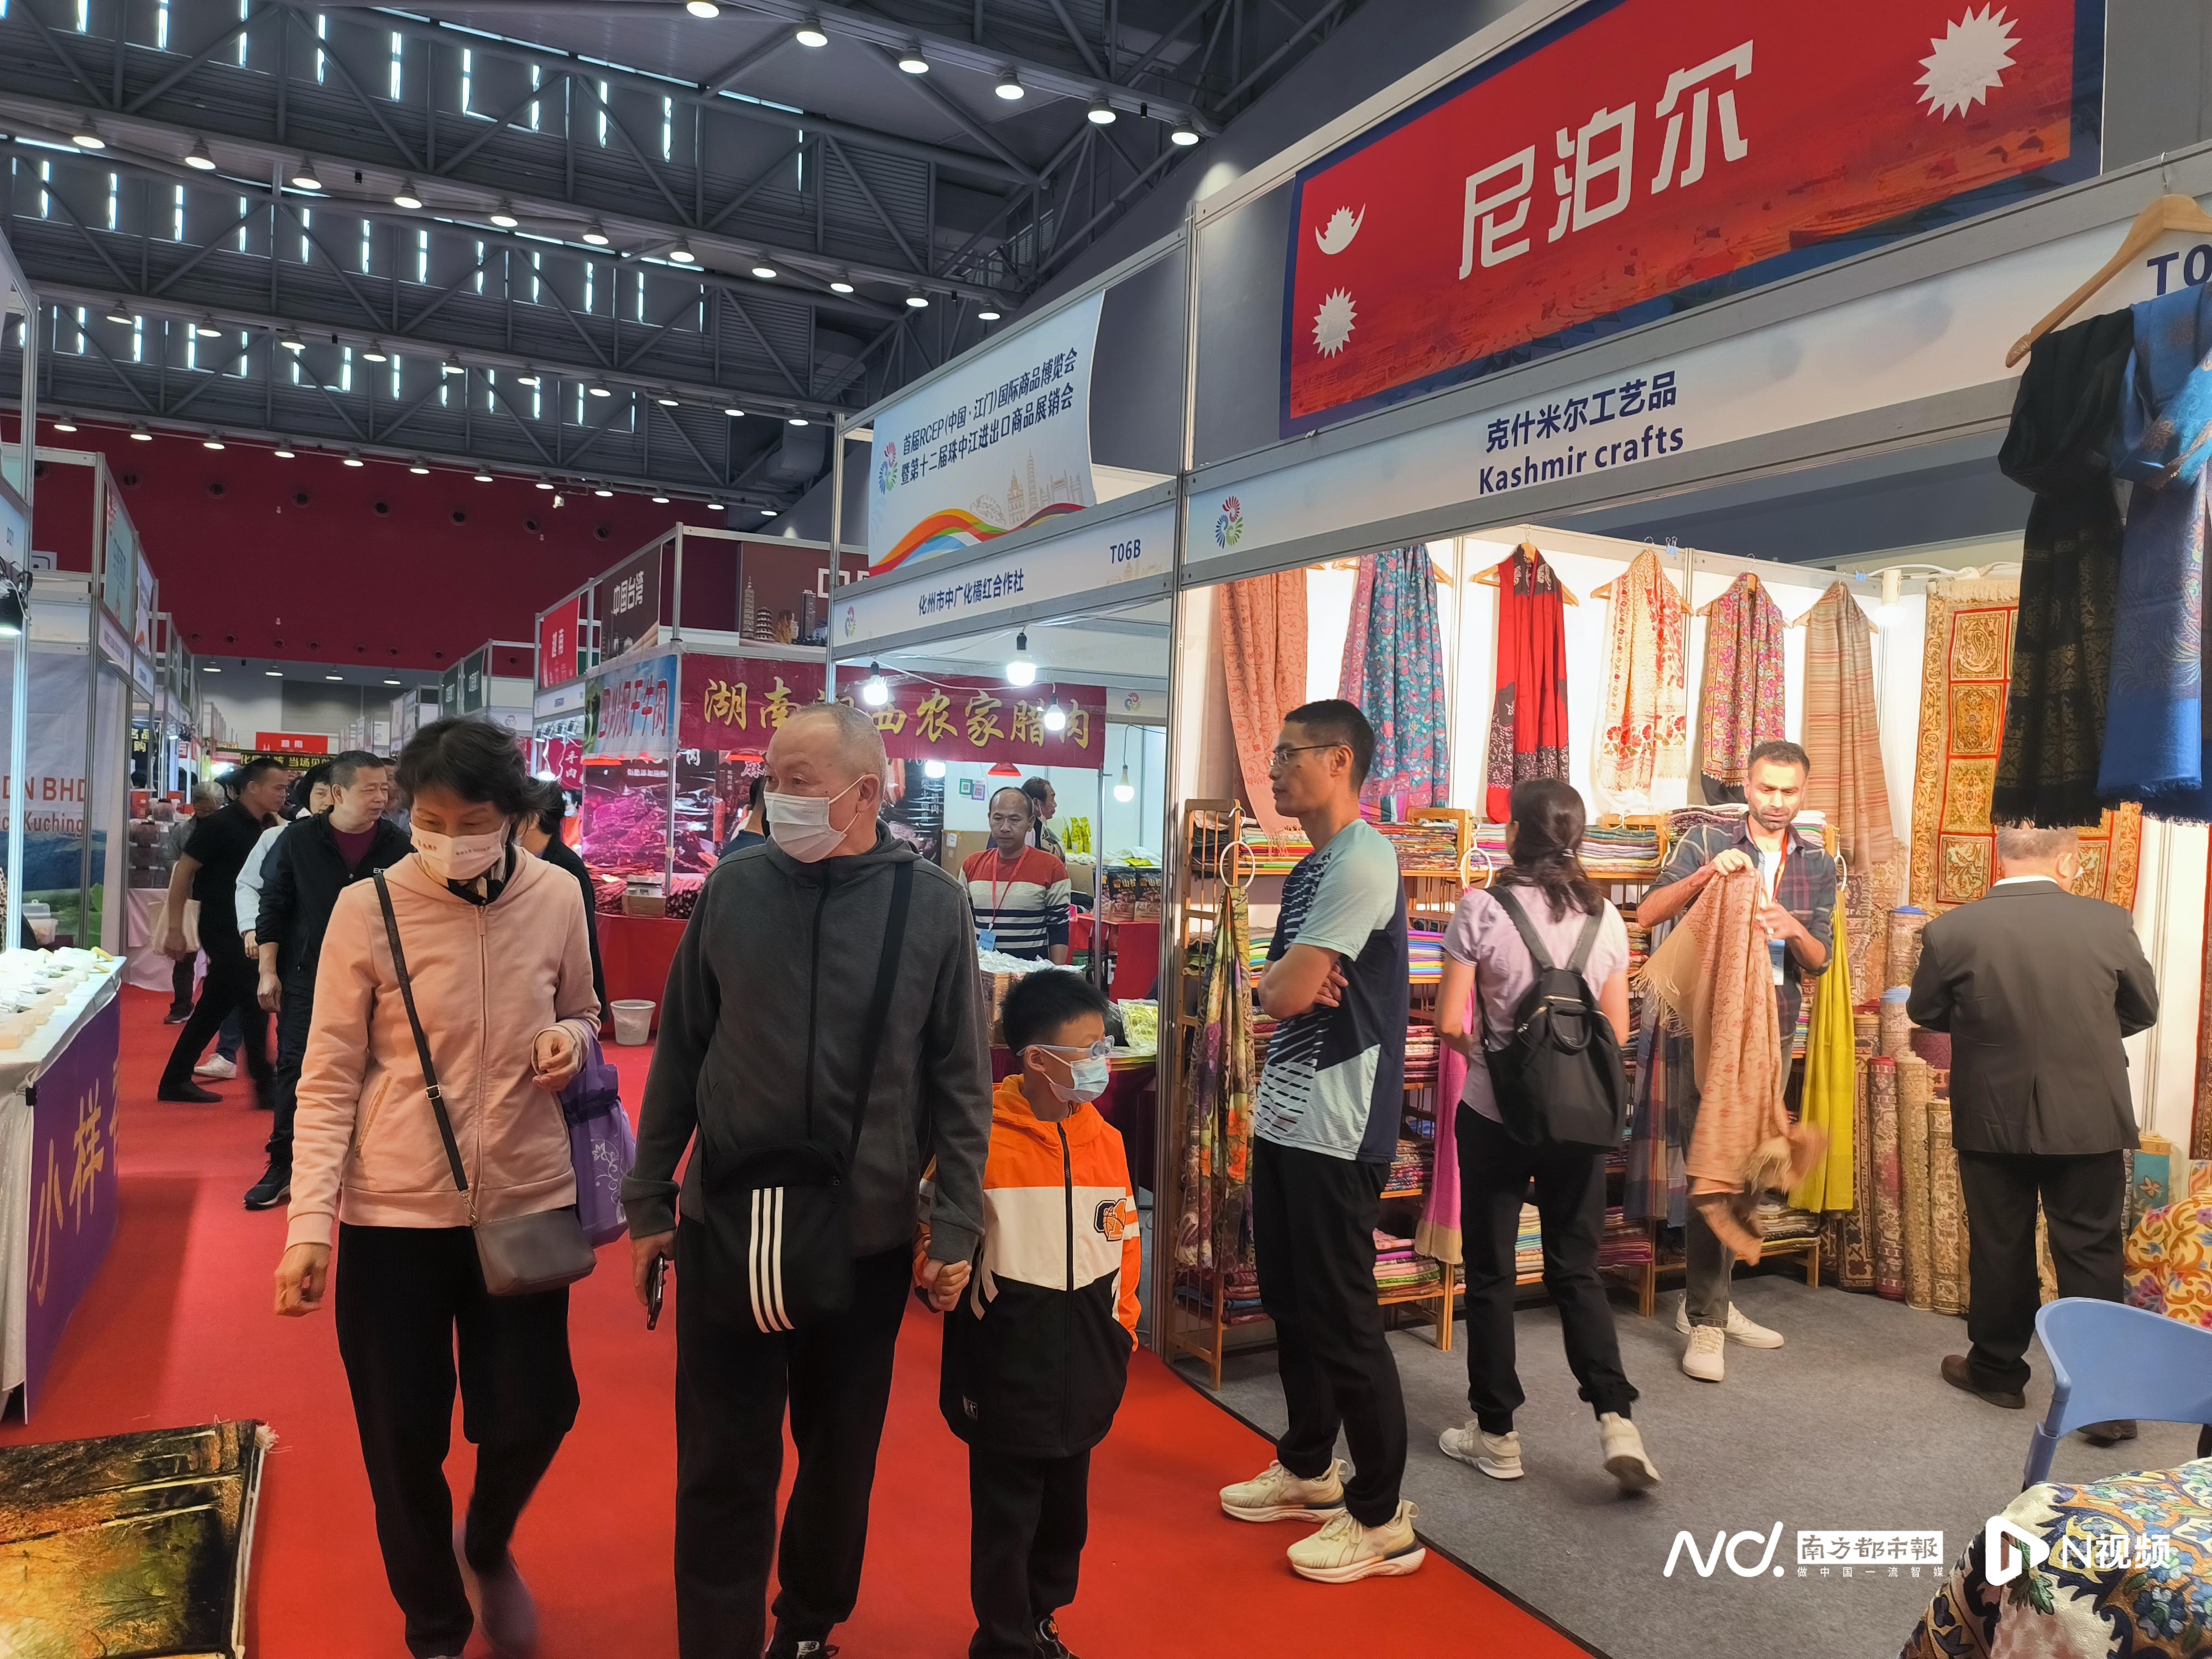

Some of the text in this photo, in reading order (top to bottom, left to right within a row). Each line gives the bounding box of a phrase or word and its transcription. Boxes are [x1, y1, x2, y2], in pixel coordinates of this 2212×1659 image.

[1459, 39, 1754, 280] 尼泊尔
[901, 382, 1073, 486] 暨第十二届珠中江进出口商品展销会
[1486, 371, 1677, 453] 克什米尔工艺品
[1480, 425, 1683, 495] Kashmir crafts
[1110, 539, 1141, 564] T06B
[613, 571, 644, 615] 中国台湾
[919, 568, 1024, 615] 化州市中广化橘红合作社
[24, 812, 84, 837] Kuching
